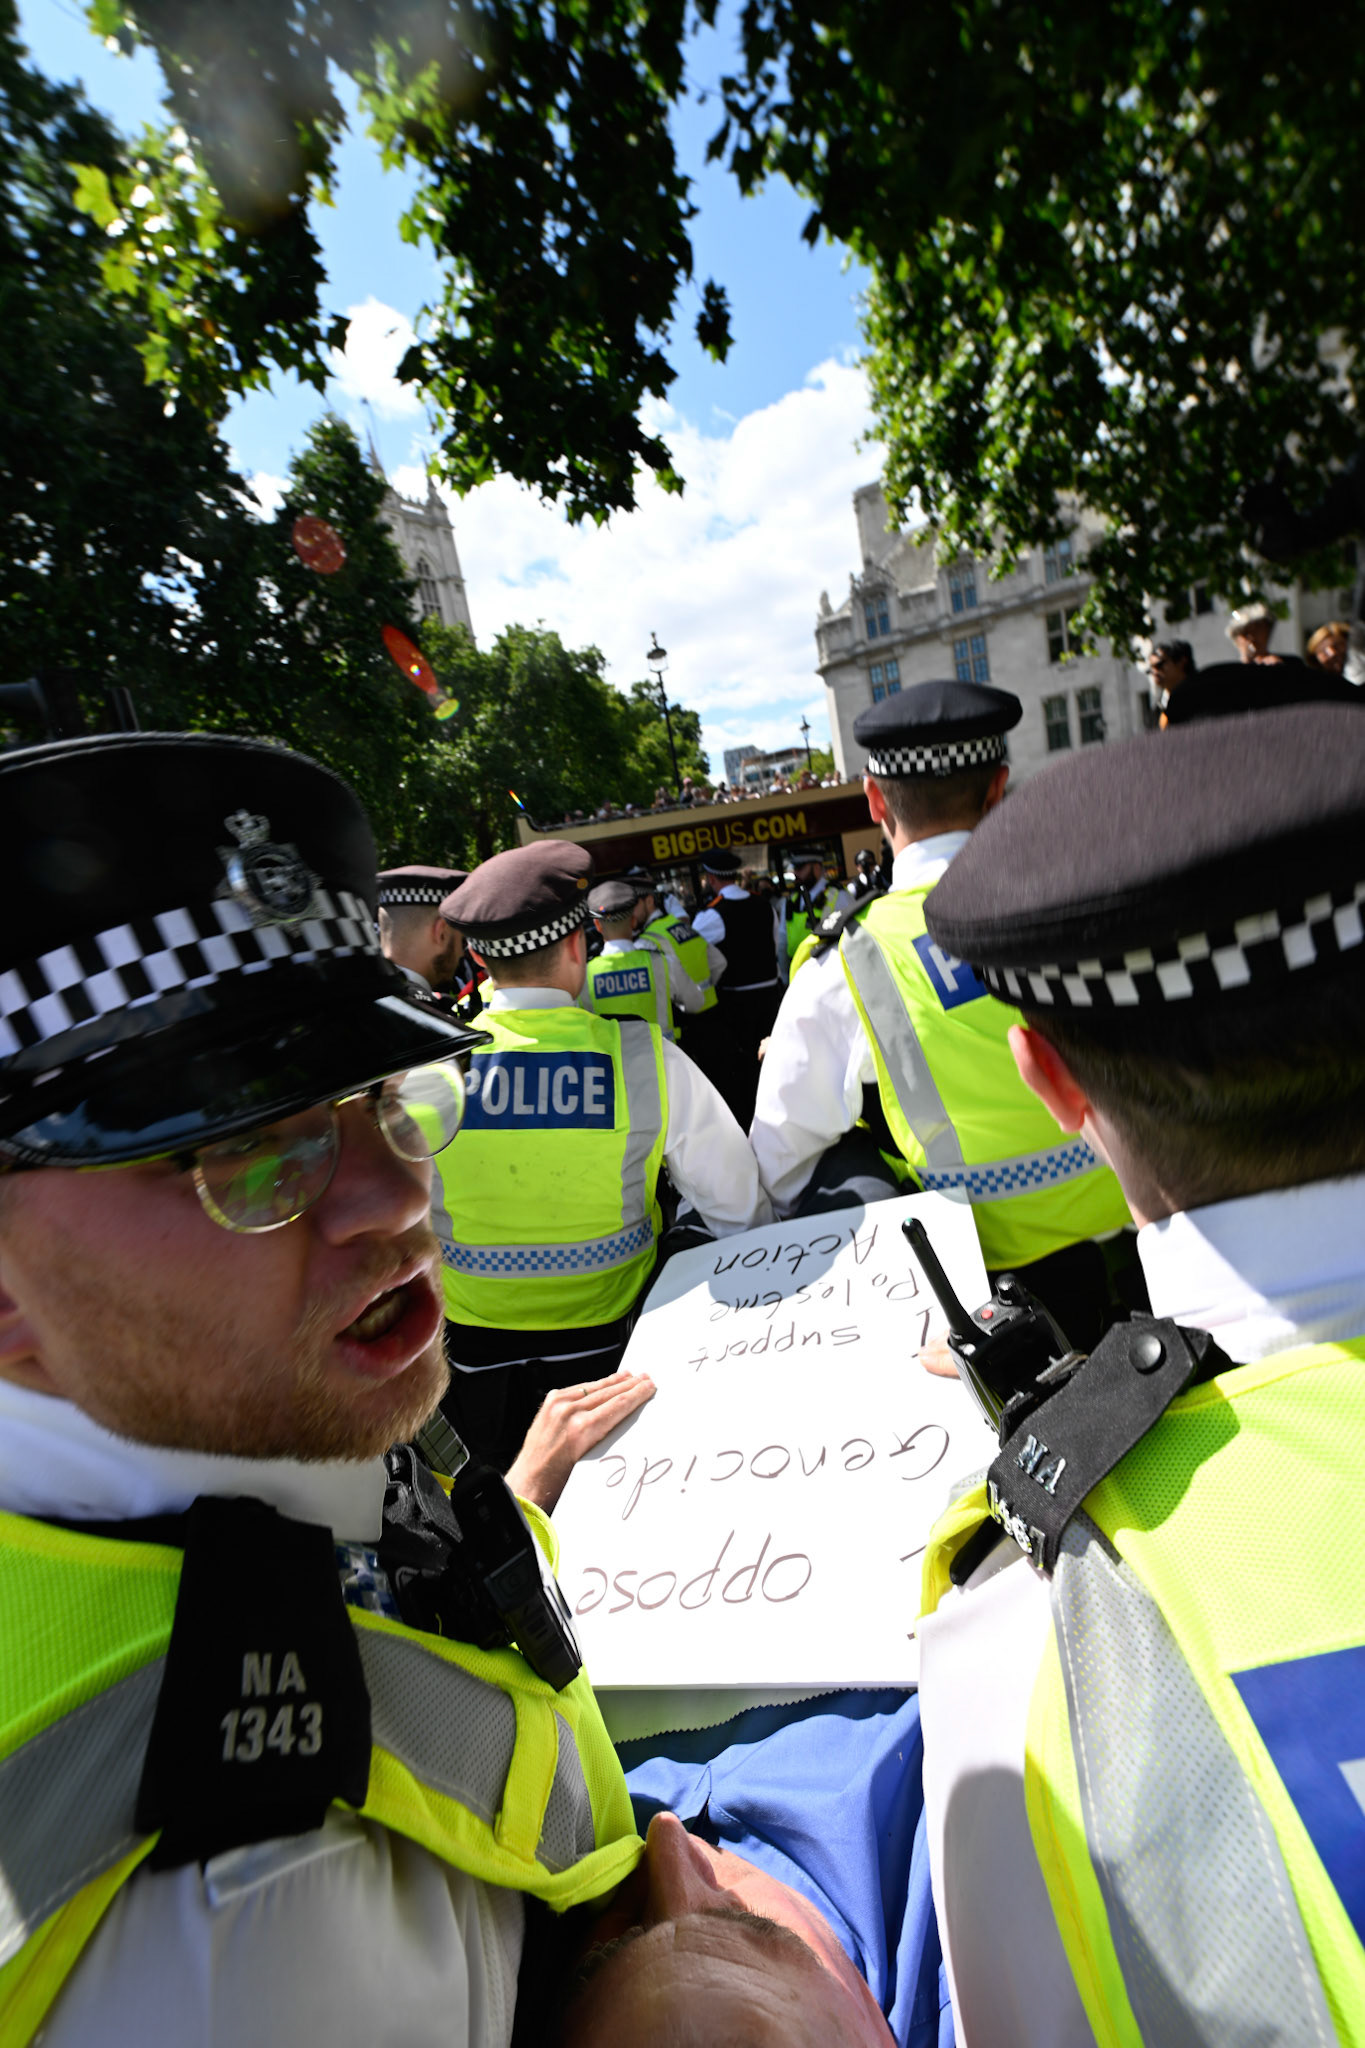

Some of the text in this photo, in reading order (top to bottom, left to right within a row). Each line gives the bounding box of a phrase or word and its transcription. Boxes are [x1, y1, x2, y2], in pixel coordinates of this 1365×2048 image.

[651, 811, 807, 860] BIGBUS.COM
[596, 970, 649, 994] POLICE
[713, 1224, 879, 1276] Action
[688, 1320, 862, 1373] support
[600, 1424, 950, 1520] Genocide
[1014, 1434, 1066, 1495] NA
[575, 1529, 812, 1615] oppose
[241, 1651, 307, 1696] NA
[220, 1702, 323, 1762] 1343
